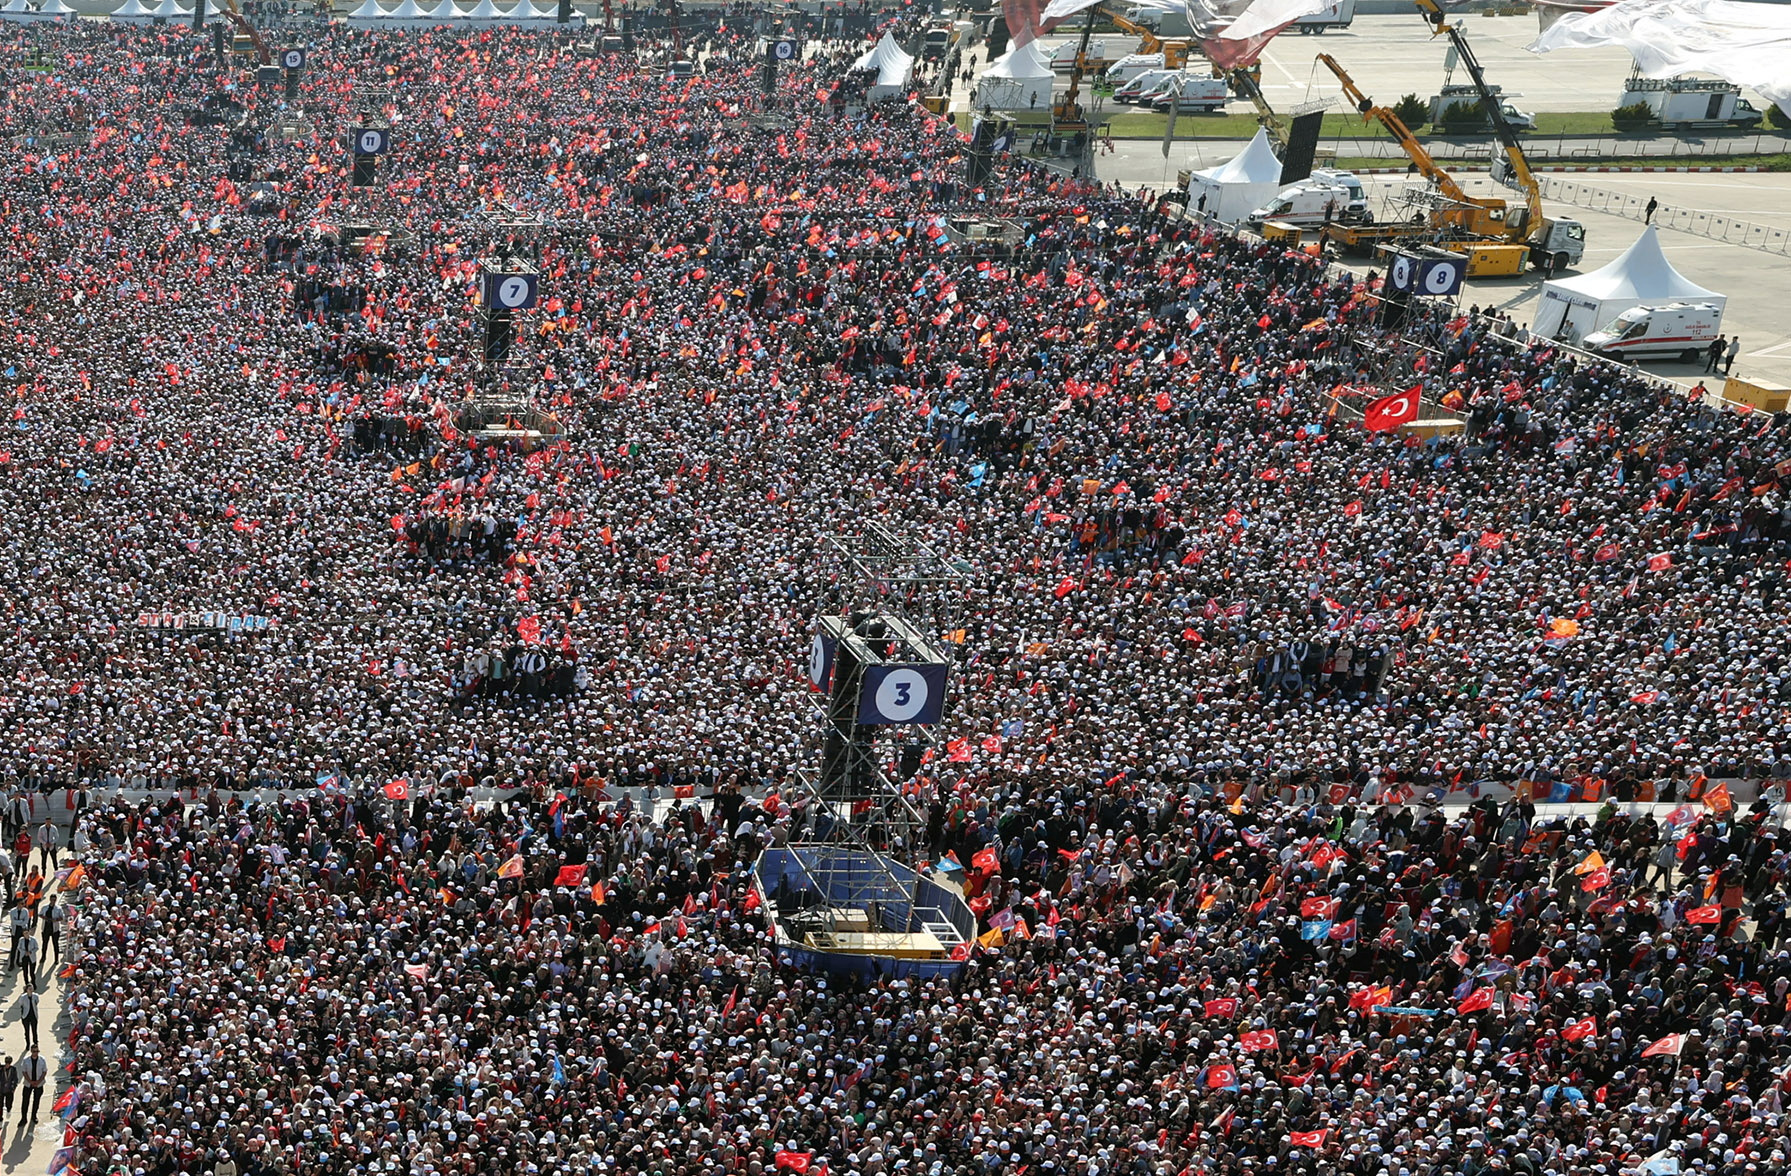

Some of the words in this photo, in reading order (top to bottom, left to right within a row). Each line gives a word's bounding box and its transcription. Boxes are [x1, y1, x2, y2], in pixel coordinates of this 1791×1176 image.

[779, 46, 788, 54] 16
[289, 55, 298, 63] 15
[365, 136, 376, 146] 11
[1397, 267, 1404, 280] 8
[1436, 271, 1447, 284] 8
[509, 284, 520, 298] 7
[140, 613, 183, 628] STAJ
[893, 682, 912, 707] 3
